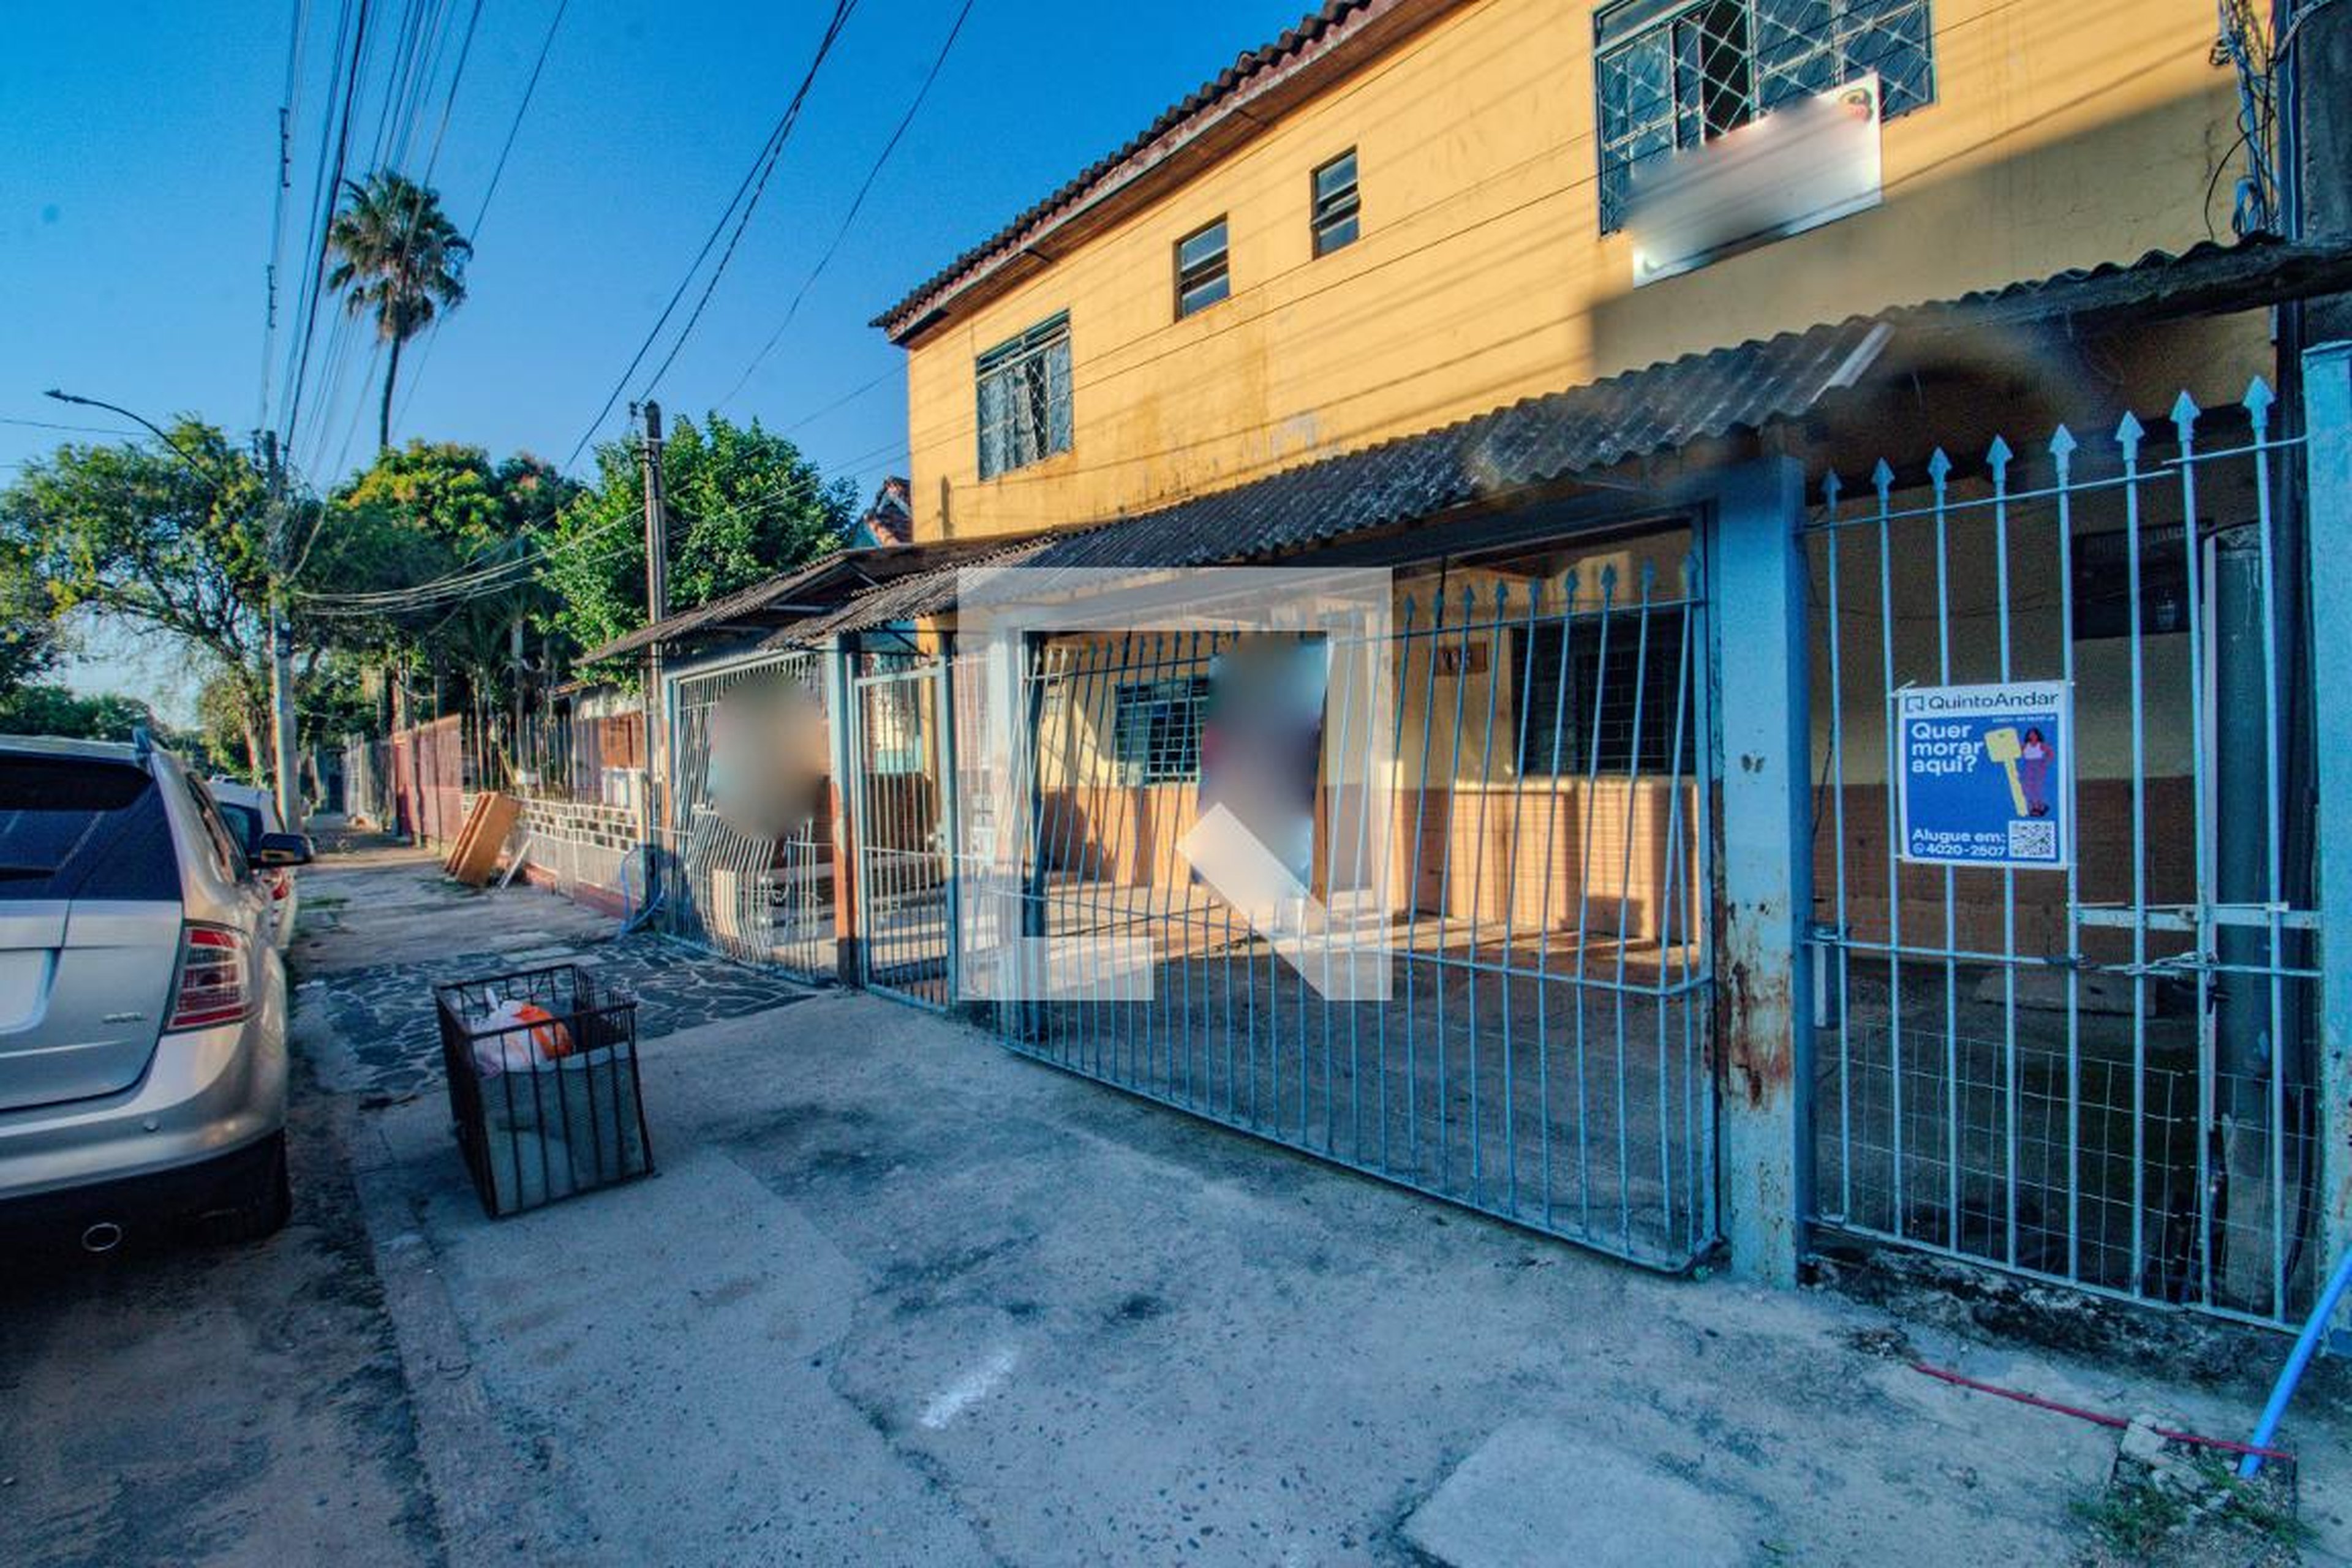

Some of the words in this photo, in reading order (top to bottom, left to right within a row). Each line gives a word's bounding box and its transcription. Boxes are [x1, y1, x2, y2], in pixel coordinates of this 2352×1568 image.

[1928, 692, 2059, 710] QuintoAndar
[1911, 722, 1972, 739] Quer
[1911, 740, 1984, 756] morar
[1911, 756, 1978, 776] aqui?
[1912, 828, 1971, 843] Alugue
[1974, 832, 2007, 843] em:
